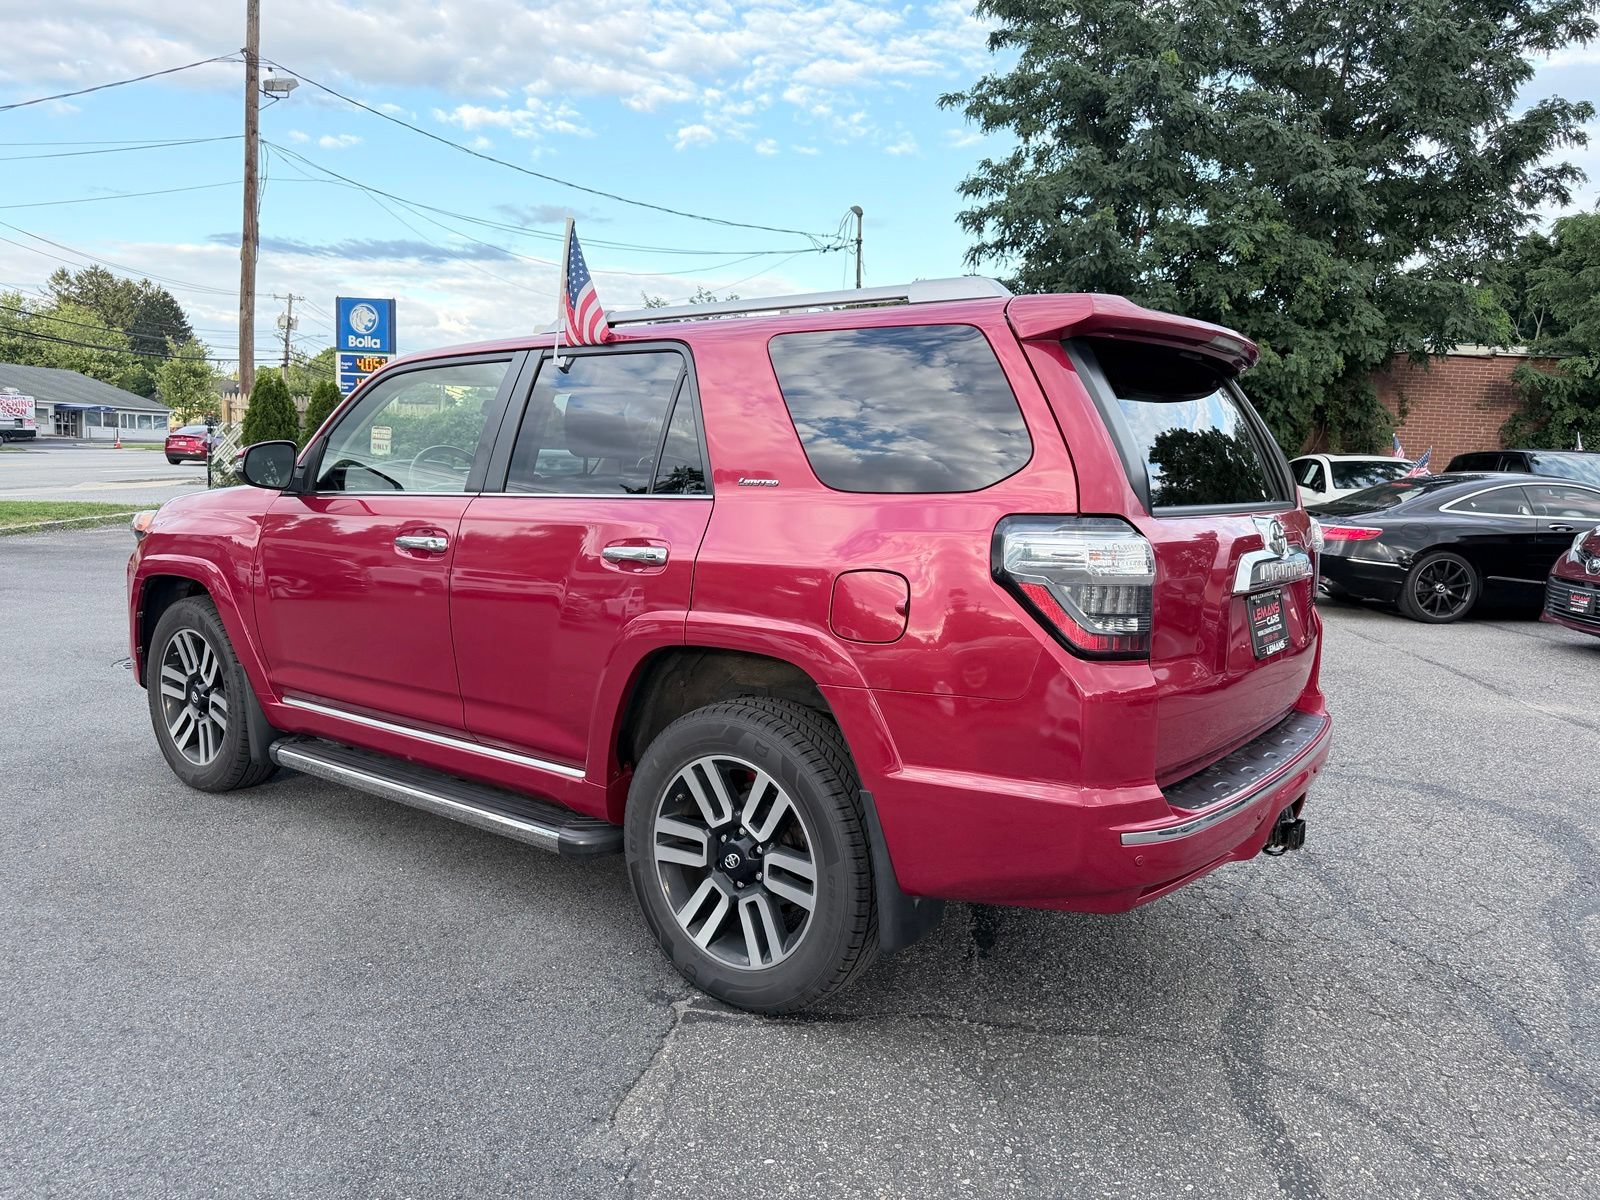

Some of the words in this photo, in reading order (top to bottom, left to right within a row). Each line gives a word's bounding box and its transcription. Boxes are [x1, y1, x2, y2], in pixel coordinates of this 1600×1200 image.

[348, 335, 380, 348] Bolla
[0, 399, 33, 408] PENING
[1, 405, 27, 415] SOON
[1252, 602, 1280, 622] LEMANS
[1266, 613, 1280, 625] CARS
[1265, 639, 1286, 655] LEMANS
